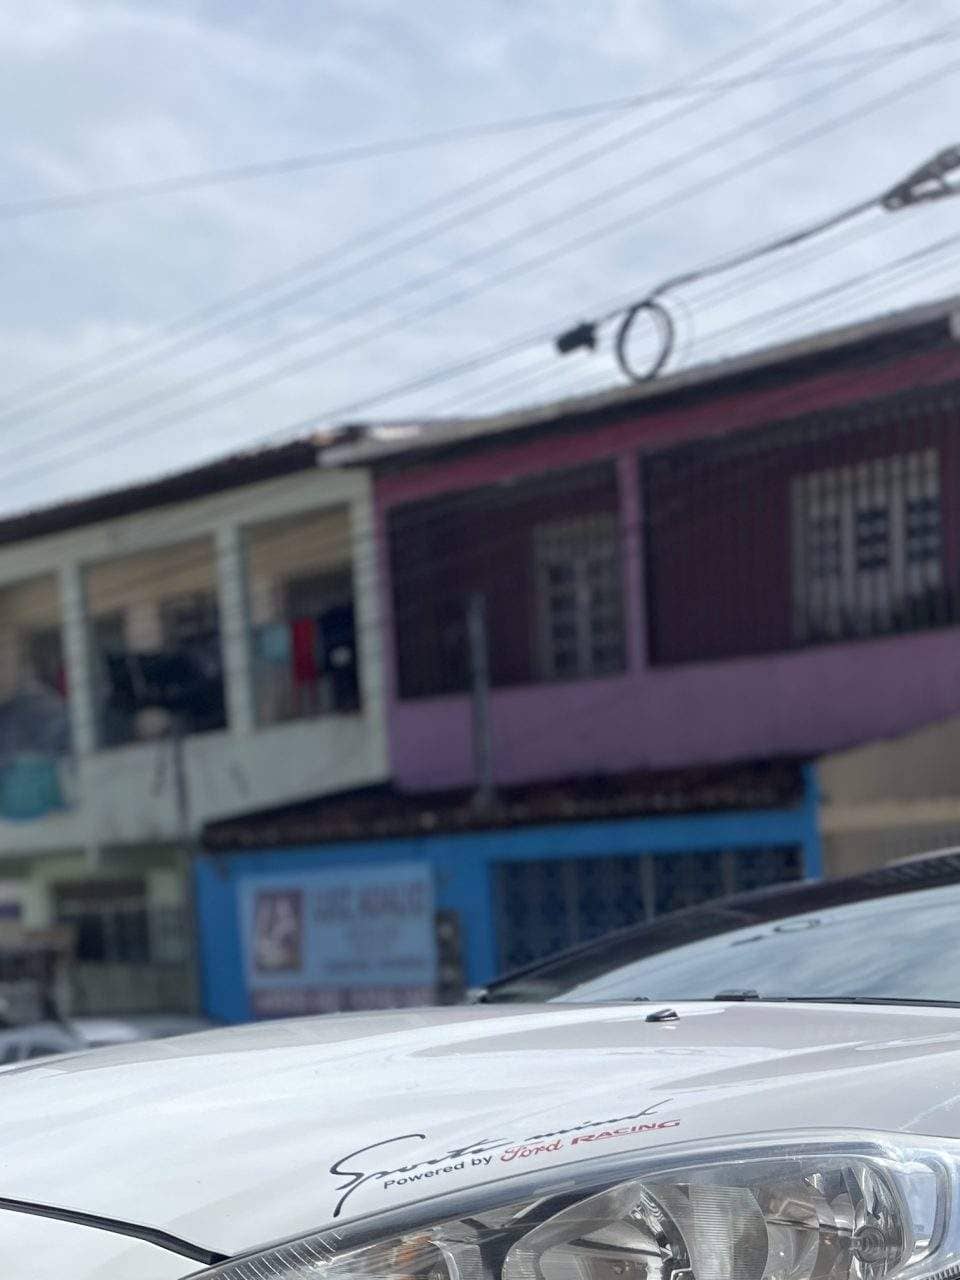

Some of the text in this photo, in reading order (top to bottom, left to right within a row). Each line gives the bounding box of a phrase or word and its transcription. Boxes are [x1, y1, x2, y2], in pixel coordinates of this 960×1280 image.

[383, 1119, 681, 1189] Powered by Ford RACING
